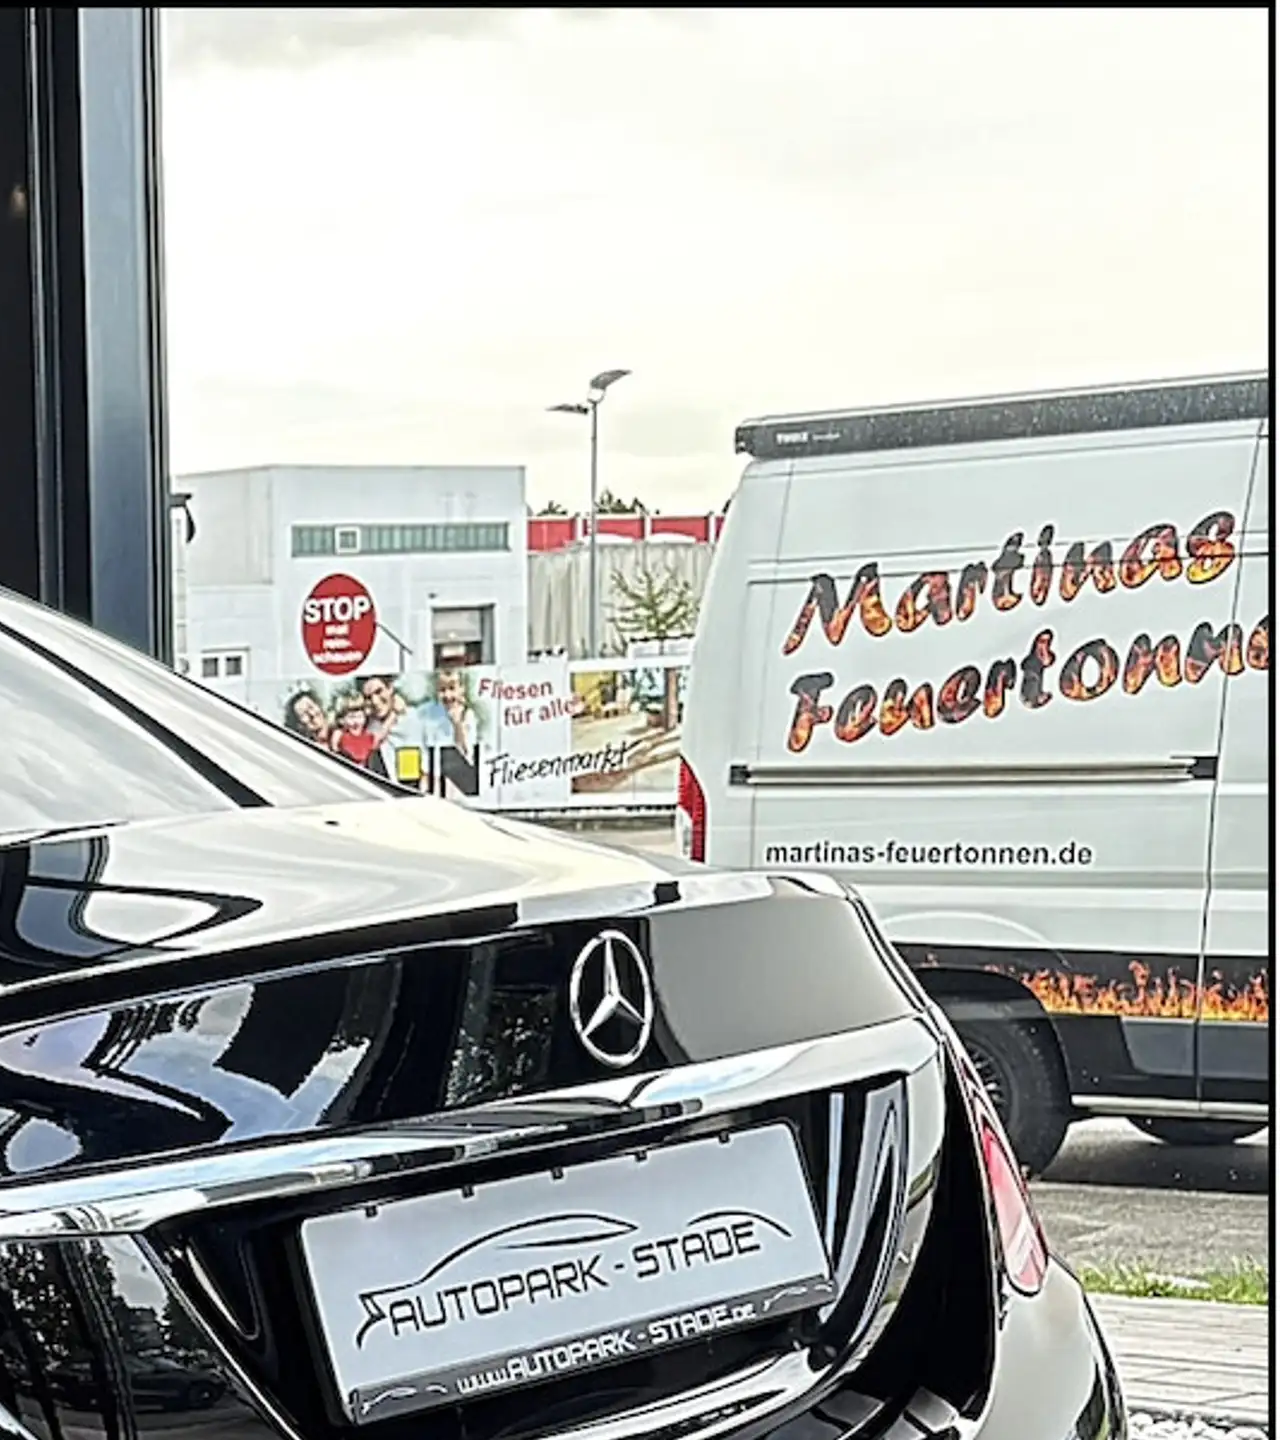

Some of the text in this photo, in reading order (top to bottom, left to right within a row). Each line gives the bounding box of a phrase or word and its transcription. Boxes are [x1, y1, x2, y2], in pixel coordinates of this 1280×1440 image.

[782, 508, 1236, 655] Martinas
[304, 595, 371, 624] STOP
[478, 678, 554, 700] Fliesen
[504, 703, 532, 727] für
[485, 740, 628, 789] Fliesenmarkt
[765, 840, 1093, 866] martinas-feuertonnen.de
[387, 1254, 609, 1336] AUTOPARK
[635, 1222, 762, 1277] STADE
